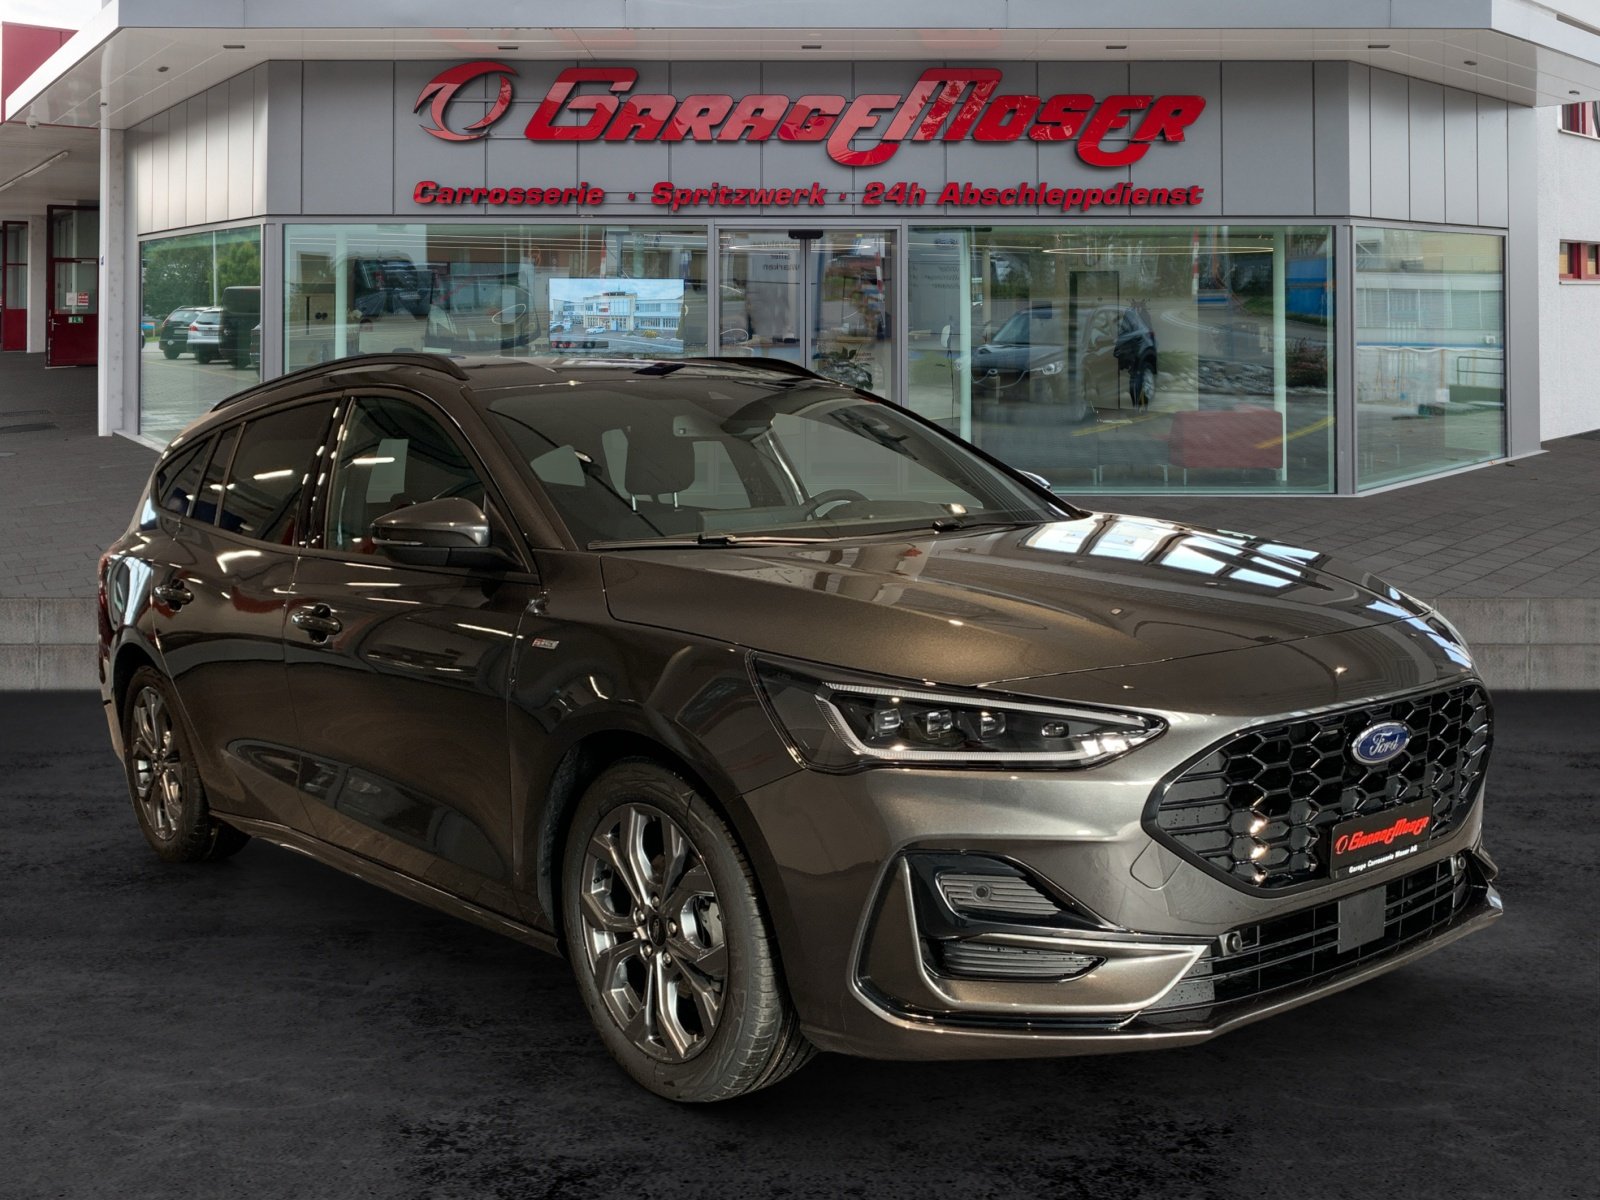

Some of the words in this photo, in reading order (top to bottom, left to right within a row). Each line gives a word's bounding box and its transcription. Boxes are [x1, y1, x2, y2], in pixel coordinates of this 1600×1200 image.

[413, 181, 605, 206] Carrosserie
[651, 181, 826, 211] Spritzwerk
[862, 181, 927, 206] 24h
[936, 181, 1204, 211] Abschleppdienst
[1369, 731, 1400, 757] Ford
